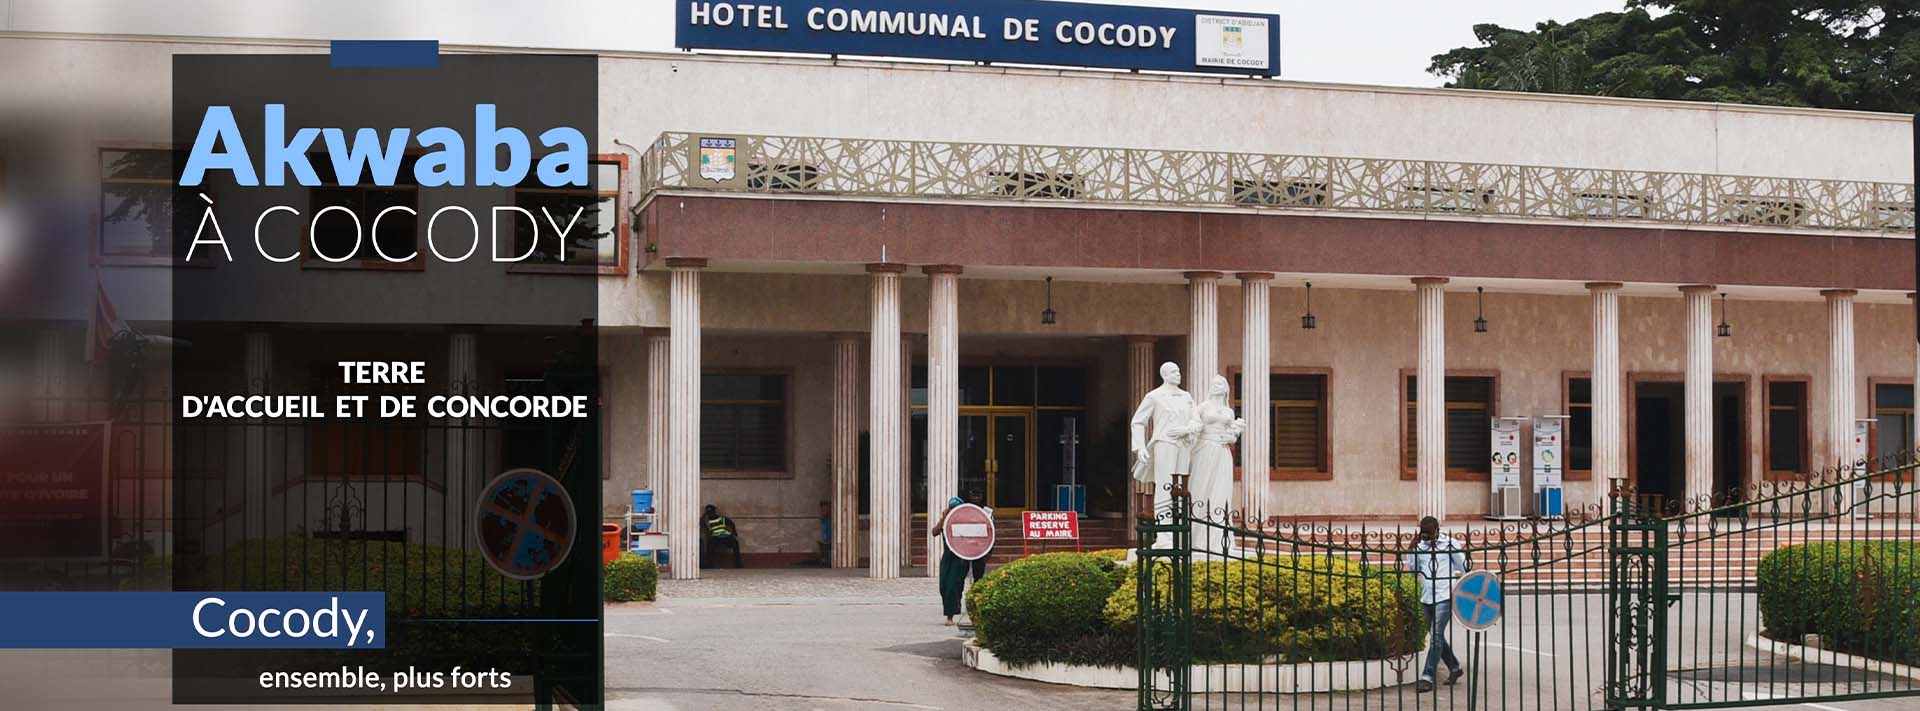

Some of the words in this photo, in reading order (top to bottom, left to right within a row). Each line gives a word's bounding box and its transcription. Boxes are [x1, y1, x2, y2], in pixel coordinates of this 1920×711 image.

[691, 2, 789, 29] HOTEL
[807, 7, 987, 39] COMMUNAL
[1003, 17, 1040, 42] DE
[1055, 20, 1177, 49] COCODY
[1201, 17, 1230, 25] DISTRICT
[1231, 18, 1265, 27] D'ABIDJAN
[1201, 57, 1225, 65] MAIRIE
[1237, 58, 1264, 66] COCODY
[1030, 513, 1068, 521] PARKING
[1030, 521, 1070, 529] RESERVE
[1030, 530, 1040, 538] AU
[1046, 530, 1072, 538] MAIRE
